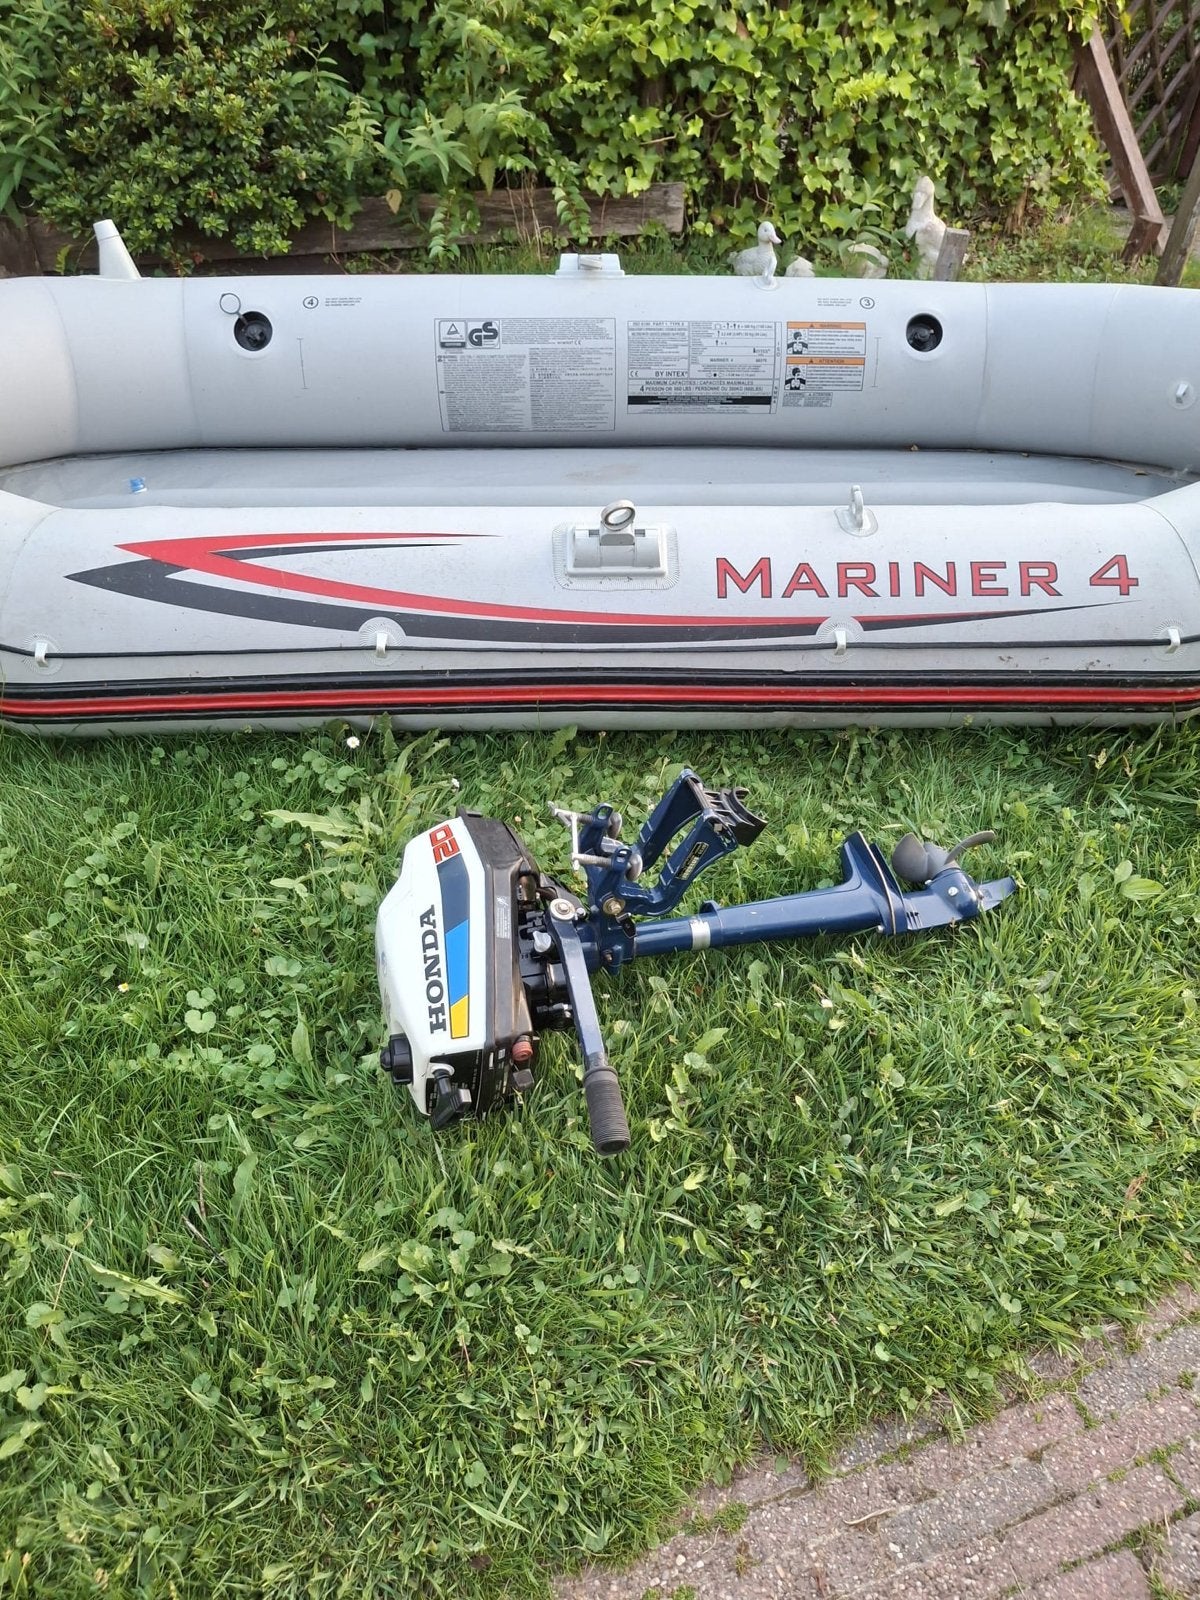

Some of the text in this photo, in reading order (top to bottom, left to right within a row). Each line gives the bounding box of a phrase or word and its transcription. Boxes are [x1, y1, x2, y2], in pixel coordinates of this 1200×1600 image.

[468, 321, 499, 347] GS
[716, 554, 1139, 600] MARINER 4
[418, 904, 448, 1036] HONDA
